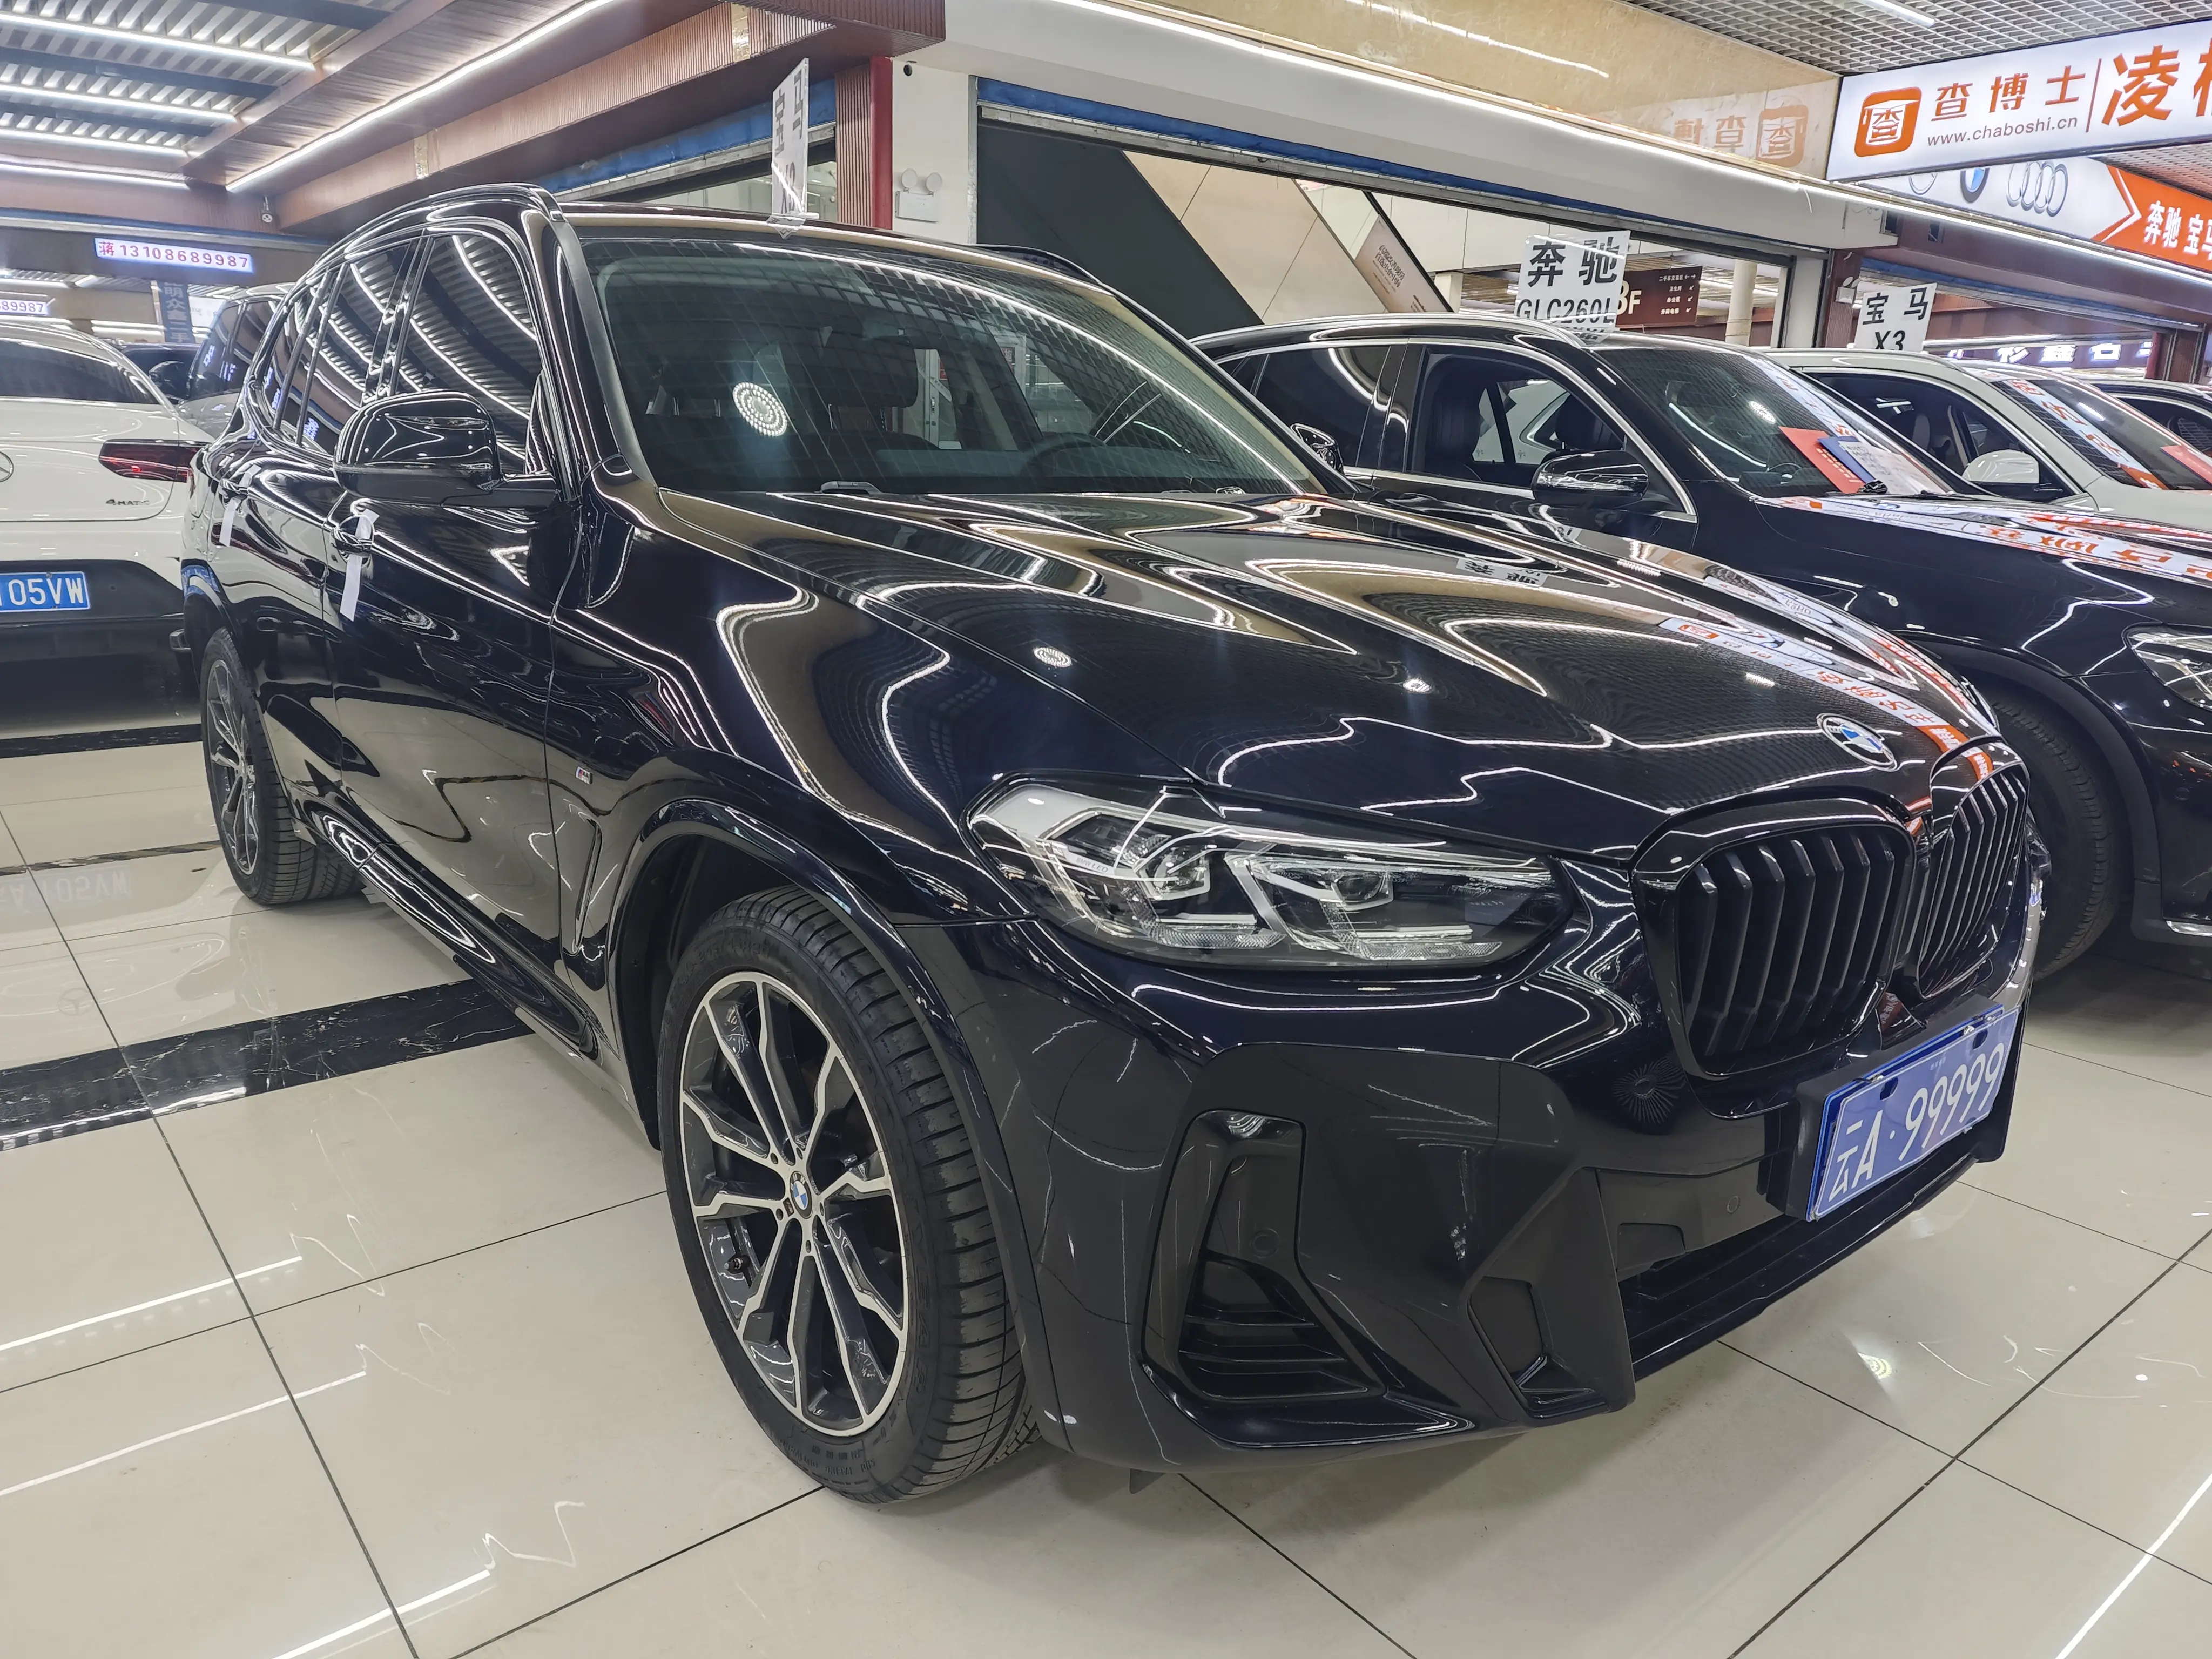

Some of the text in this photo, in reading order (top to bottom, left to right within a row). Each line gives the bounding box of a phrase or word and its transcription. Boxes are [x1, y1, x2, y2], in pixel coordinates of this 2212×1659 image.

[1931, 65, 2086, 122] 查博士
[1927, 116, 2078, 146] www.chaboshi.cn
[2144, 200, 2182, 248] 奔驰
[119, 244, 248, 268] 13108689987
[1527, 236, 1620, 288] 奔驰
[0, 300, 44, 313] 89987
[1516, 298, 1615, 323] GLC260L
[1863, 287, 1929, 325] 宝马
[1874, 329, 1906, 350] X3
[0, 578, 84, 606] 05VW
